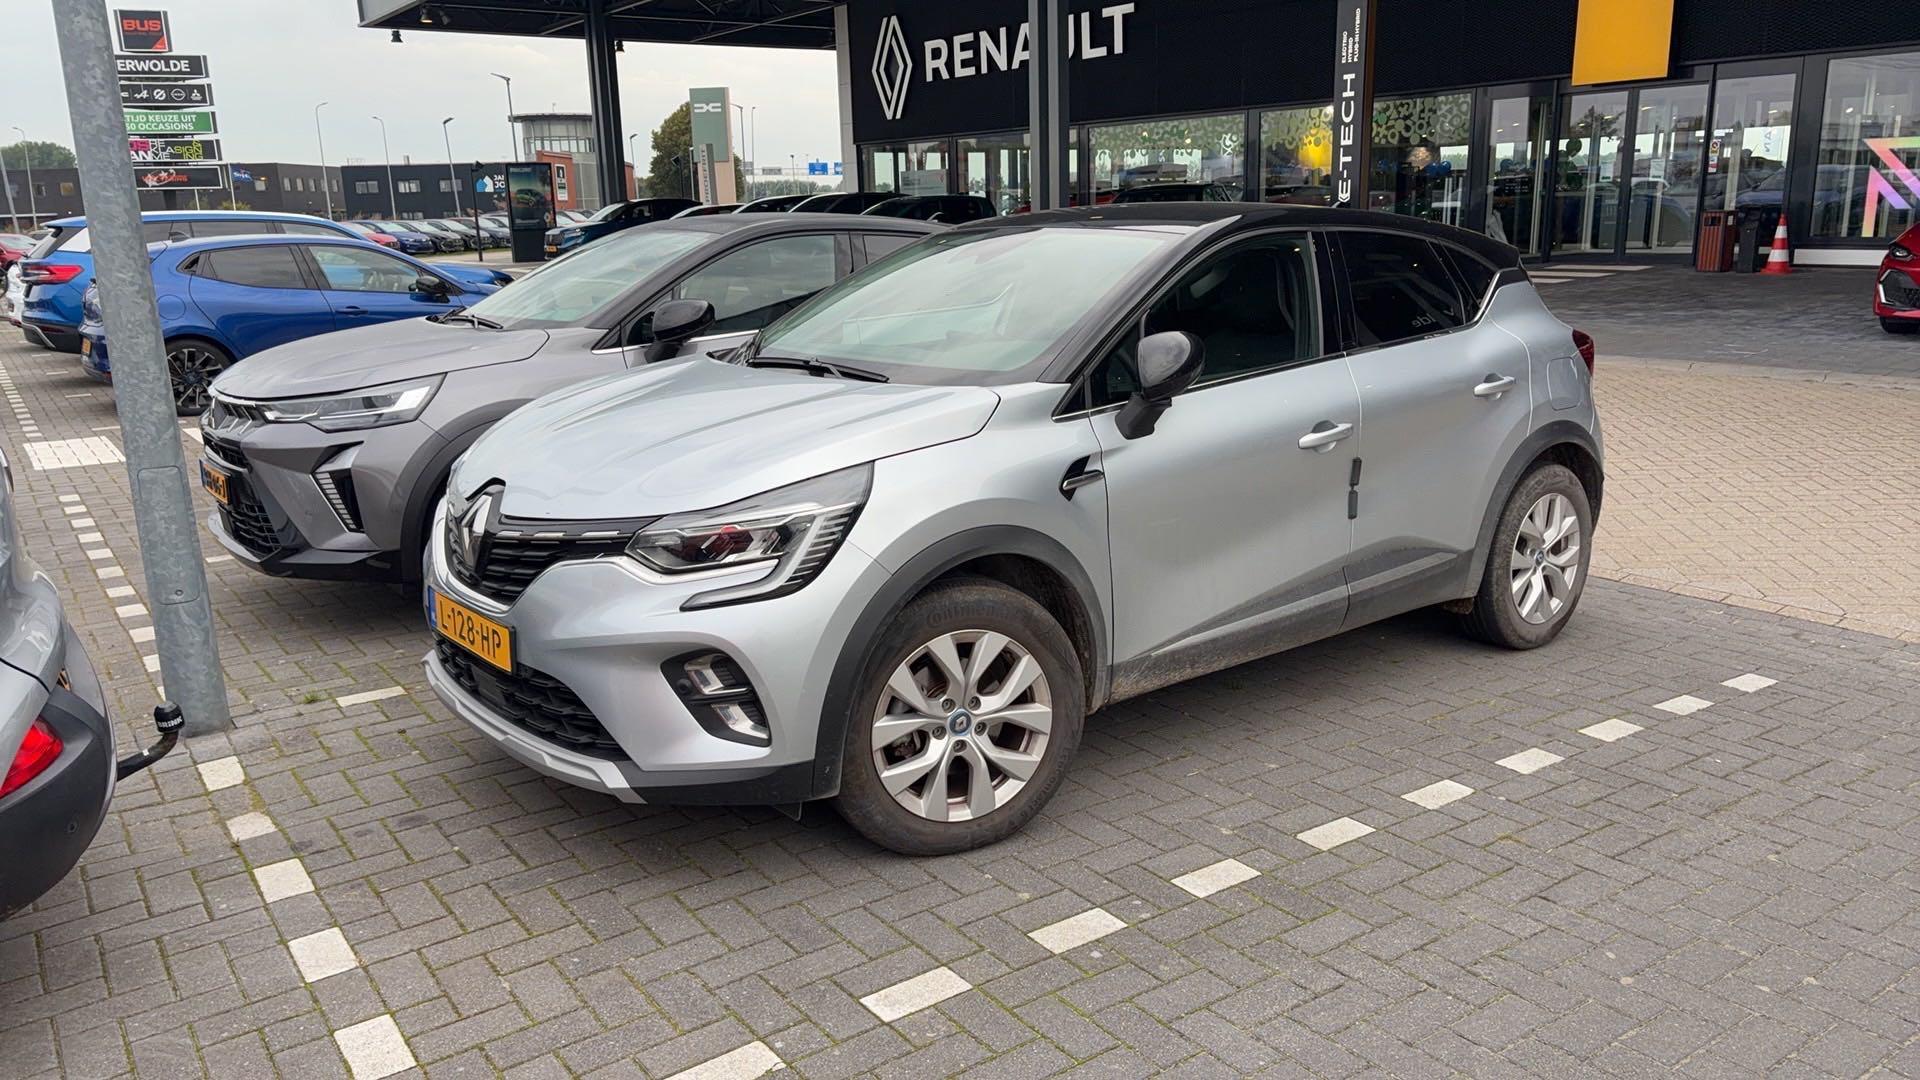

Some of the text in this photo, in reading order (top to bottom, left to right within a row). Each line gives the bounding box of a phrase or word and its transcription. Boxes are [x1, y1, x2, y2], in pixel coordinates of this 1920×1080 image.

[122, 19, 162, 31] BUS
[923, 2, 1135, 83] RENALT
[139, 123, 194, 131] OCCASIONS
[1337, 73, 1356, 203] E-TECH
[439, 600, 501, 659] L-128-HP
